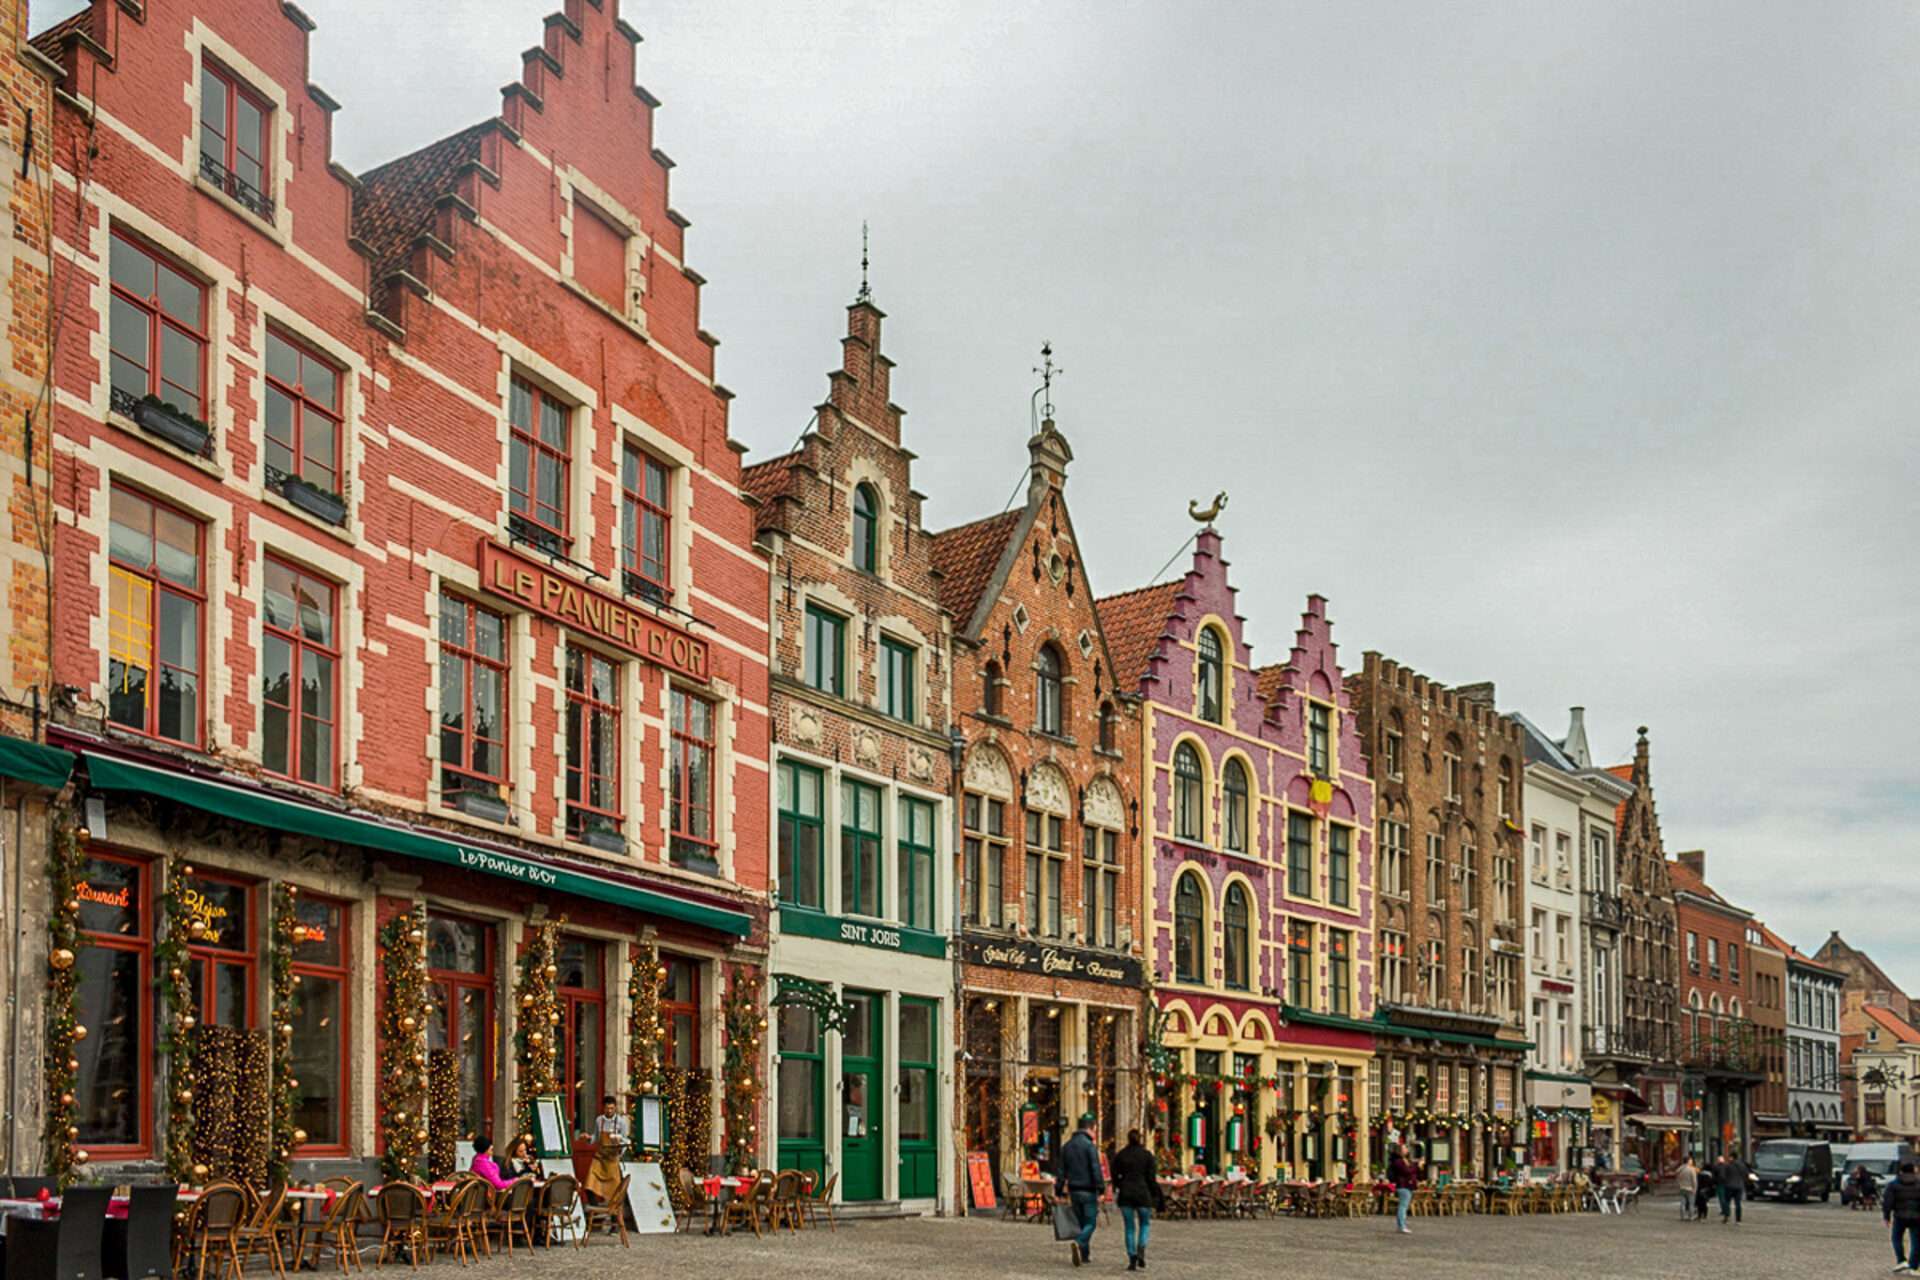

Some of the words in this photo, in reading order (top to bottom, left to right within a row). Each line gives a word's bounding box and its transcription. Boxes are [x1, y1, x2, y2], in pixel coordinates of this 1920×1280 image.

[541, 573, 642, 649] PANIER
[648, 630, 704, 674] D'OR
[458, 848, 477, 865] Le
[478, 853, 526, 877] Panier
[841, 922, 867, 942] SINT
[870, 928, 900, 947] JORIS
